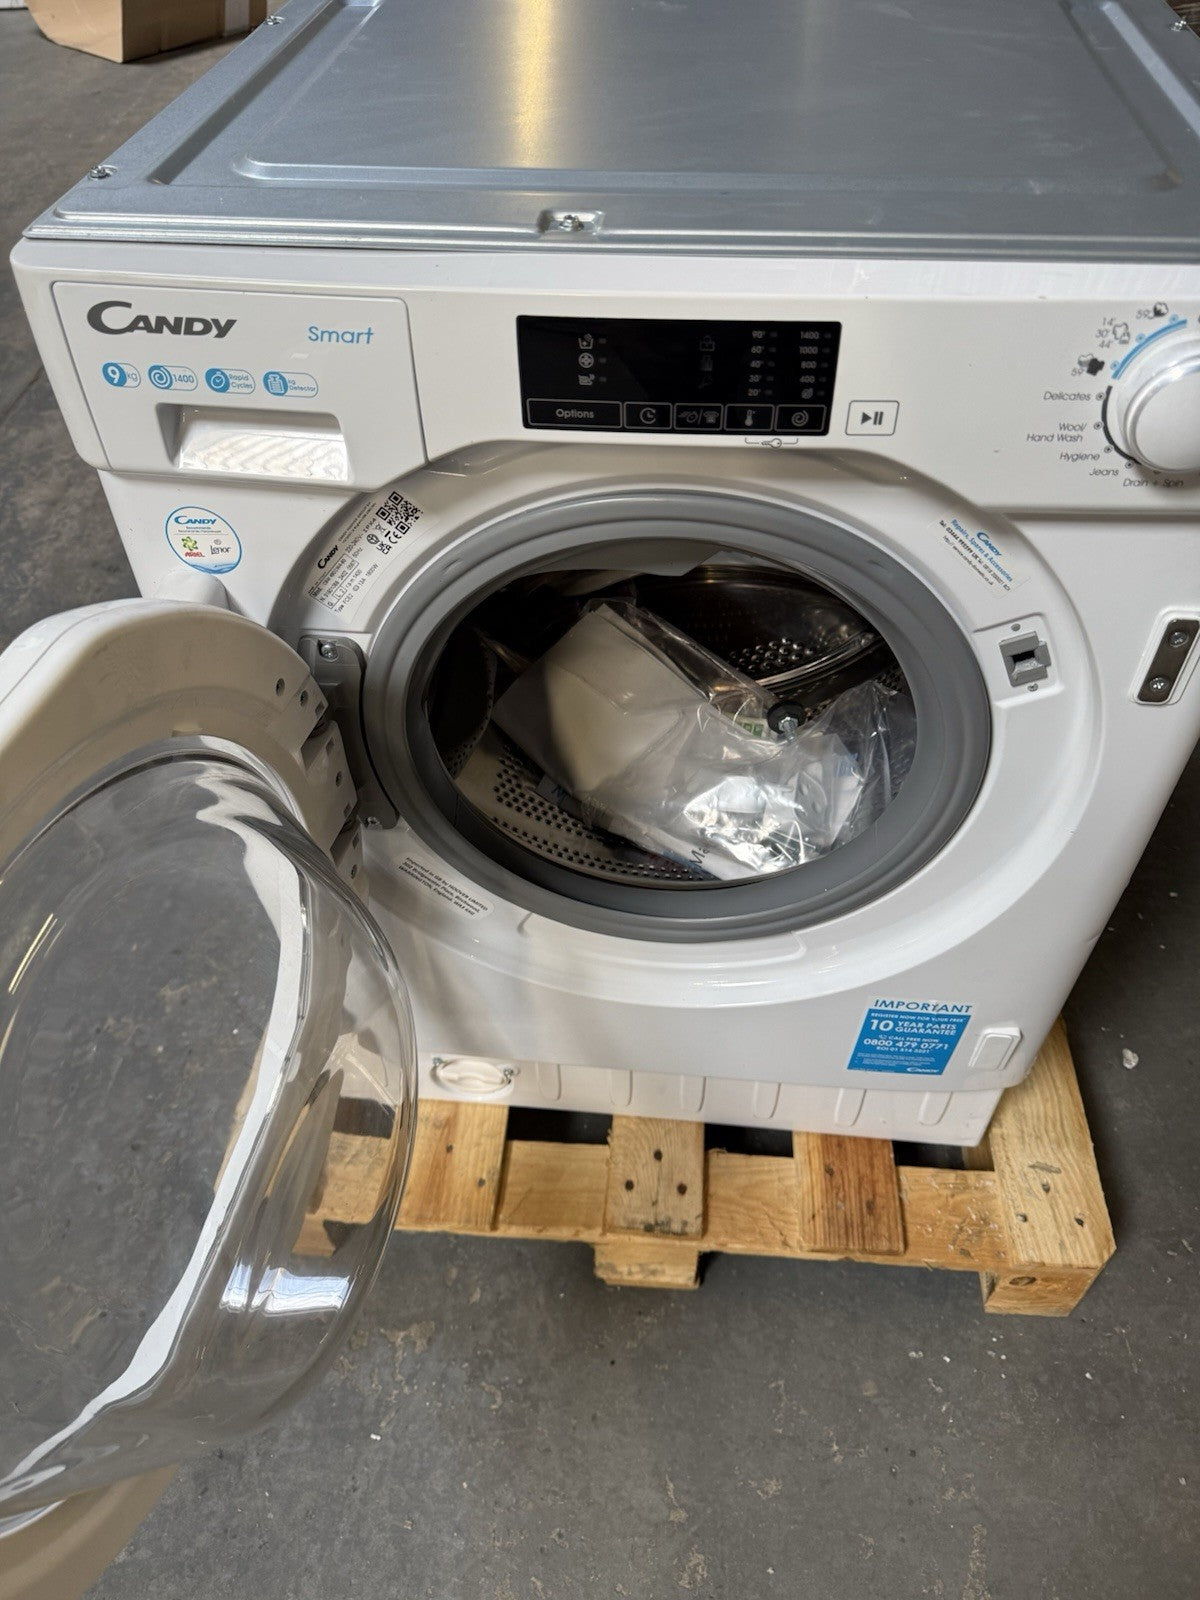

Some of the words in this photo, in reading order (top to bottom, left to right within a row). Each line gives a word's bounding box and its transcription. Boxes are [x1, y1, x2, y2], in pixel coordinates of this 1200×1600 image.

[87, 300, 238, 339] CANDY
[307, 326, 375, 345] Smart
[800, 331, 820, 340] 1400
[799, 346, 819, 354] 1000
[800, 360, 817, 369] 800
[107, 365, 121, 383] 9
[173, 373, 195, 384] 1400
[228, 373, 250, 382] Rapid
[799, 375, 816, 383] 400
[230, 381, 253, 390] Cycles
[289, 384, 317, 392] Detector
[1043, 391, 1091, 401] Delicates
[555, 408, 595, 420] Options
[1058, 422, 1087, 432] Wool/
[1026, 433, 1054, 443] Hand
[1056, 433, 1083, 443] Wash
[1059, 452, 1100, 462] Hygiene
[1089, 468, 1119, 477] Jeans
[1123, 478, 1149, 488] Drain
[1162, 478, 1184, 489] Spin
[174, 516, 217, 525] CANDY
[977, 532, 1002, 556] CANDY
[210, 545, 231, 555] Lenor
[318, 545, 339, 569] CANDY
[988, 557, 1012, 581] Accessories
[448, 885, 468, 898] HOOVER
[468, 897, 488, 911] LIMITED
[873, 998, 973, 1013] IMPORTANT
[870, 1020, 894, 1032] 10
[894, 1026, 957, 1036] GUARANTEE
[863, 1038, 893, 1046] 0800
[895, 1040, 918, 1048] 479
[920, 1042, 949, 1050] 0771
